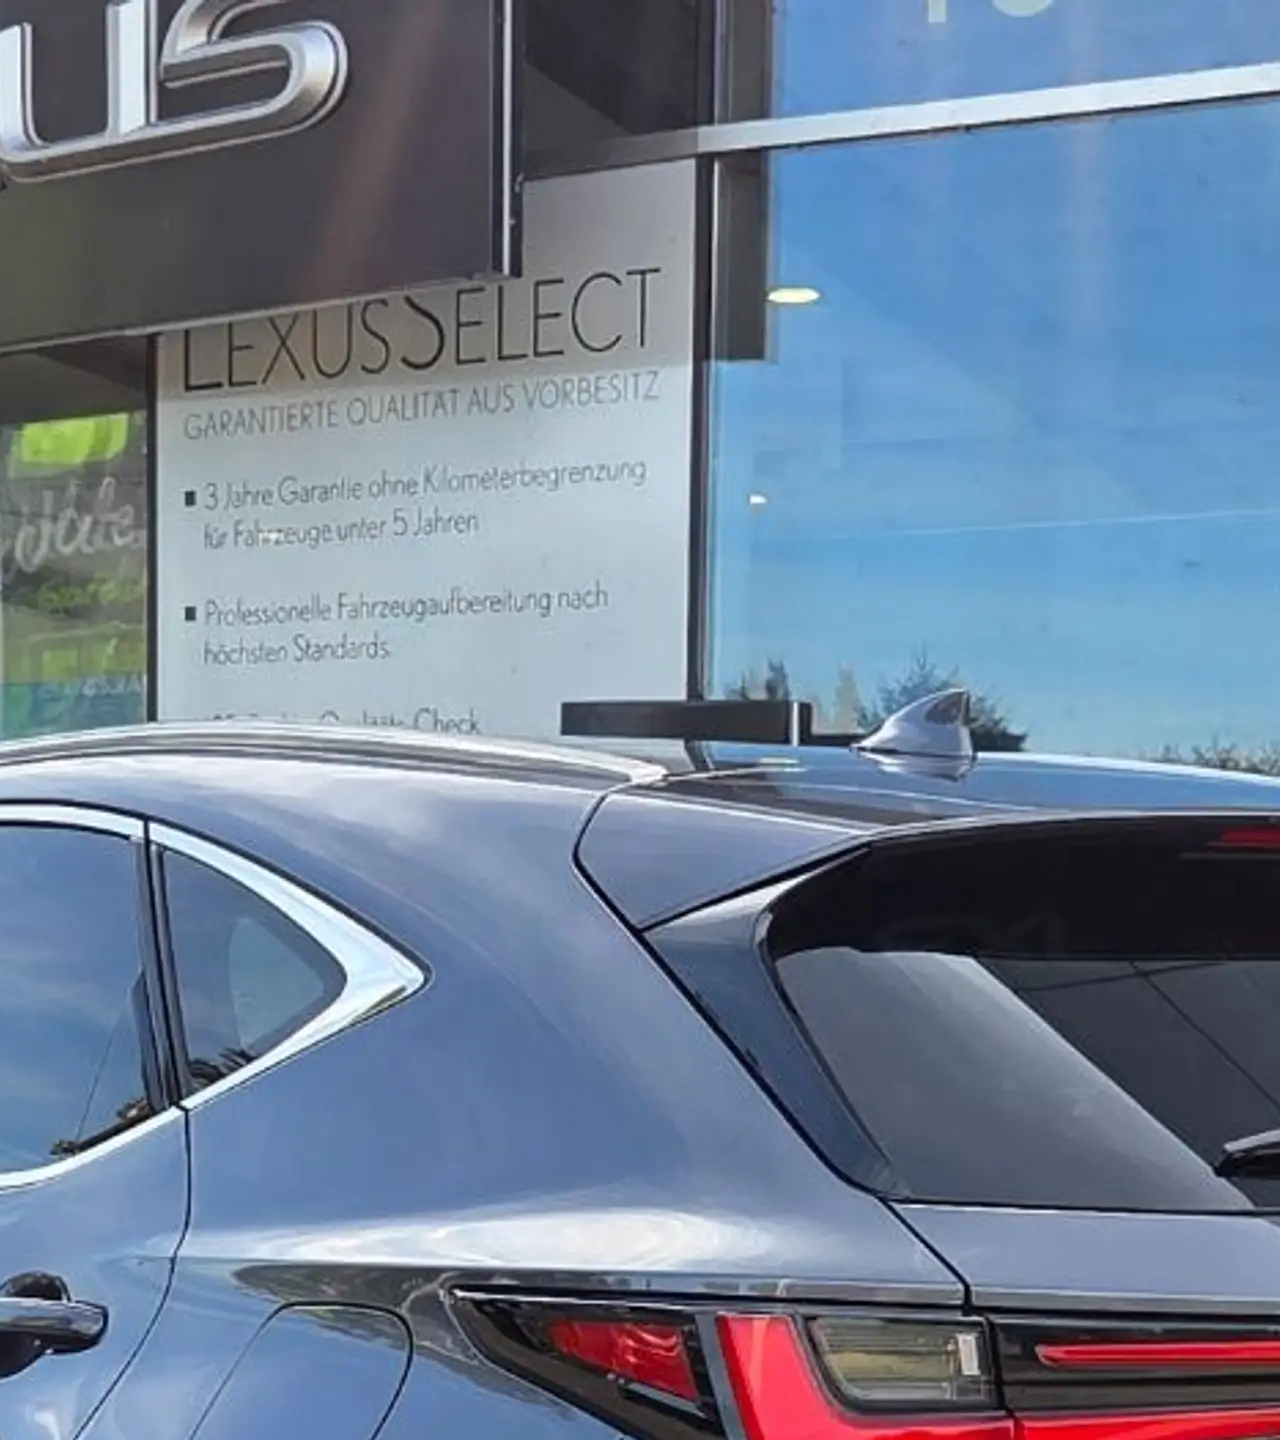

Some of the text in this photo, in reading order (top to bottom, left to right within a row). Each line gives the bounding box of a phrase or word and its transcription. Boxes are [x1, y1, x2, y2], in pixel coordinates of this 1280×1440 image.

[183, 398, 340, 440] GARANTIERTE
[466, 381, 516, 414] AUS
[521, 370, 660, 411] VORBESITZ
[204, 462, 647, 511] 3 Jahre Garantie ohne Kilometerbegrenzung
[203, 505, 479, 549] für Fahrzeuge unter 5 Jahren
[204, 579, 609, 626] Professionelle Fahrzeugaufbereitung nach
[203, 635, 289, 666] höchsten
